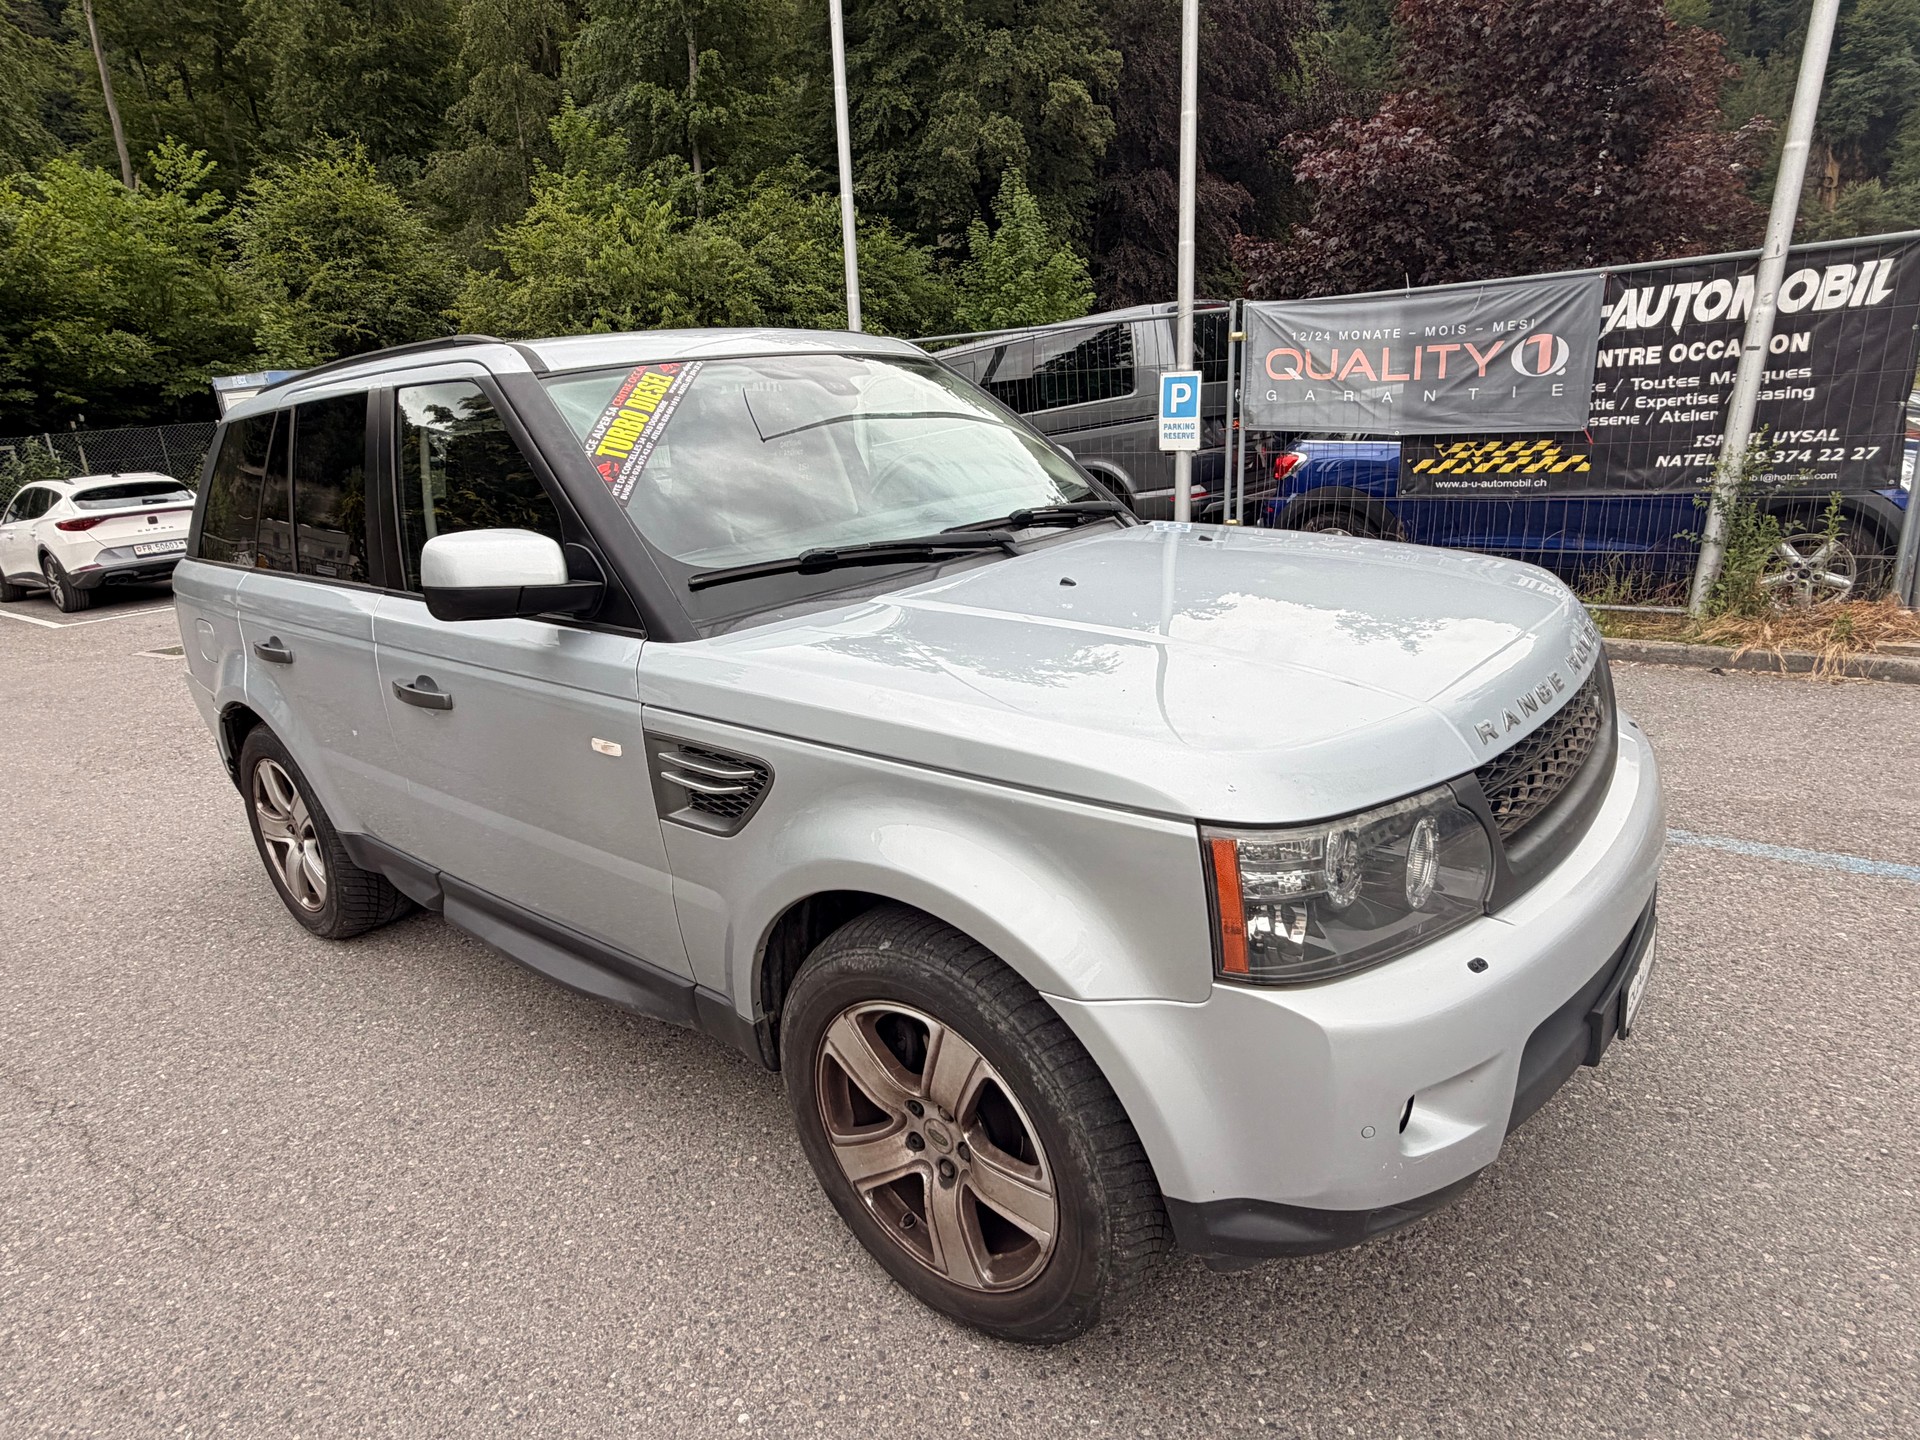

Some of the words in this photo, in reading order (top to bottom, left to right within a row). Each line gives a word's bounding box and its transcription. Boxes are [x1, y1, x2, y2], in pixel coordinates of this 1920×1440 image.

[1291, 331, 1331, 341] 12/24
[1338, 328, 1401, 341] MONATE
[1424, 324, 1467, 337] MOIS
[1492, 318, 1536, 332] MESI
[1597, 345, 1663, 368] NTRE
[1669, 331, 1811, 363] OCCAON
[1265, 340, 1506, 382] QUALITY
[1630, 375, 1700, 391] Toutes
[1709, 367, 1812, 386] Maques
[611, 382, 633, 406] CENTRE
[1170, 383, 1191, 414] P
[1266, 383, 1564, 403] GARANTIE
[1635, 392, 1720, 410] Expertise
[605, 406, 619, 416] SA
[1589, 415, 1640, 427] sserie
[1659, 409, 1720, 424] Atelier
[592, 416, 612, 438] ALPER
[594, 409, 650, 459] TURBO
[1773, 428, 1841, 444] UYSAL
[583, 438, 598, 456] AGE
[1771, 449, 1813, 463] 374
[1817, 447, 1846, 462] 22
[1850, 446, 1881, 460] 27
[617, 473, 627, 484] DE
[620, 474, 637, 499] BUREAU:
[1435, 478, 1548, 488] www.a-u-automobil.ch
[1474, 672, 1566, 746] RANGE
